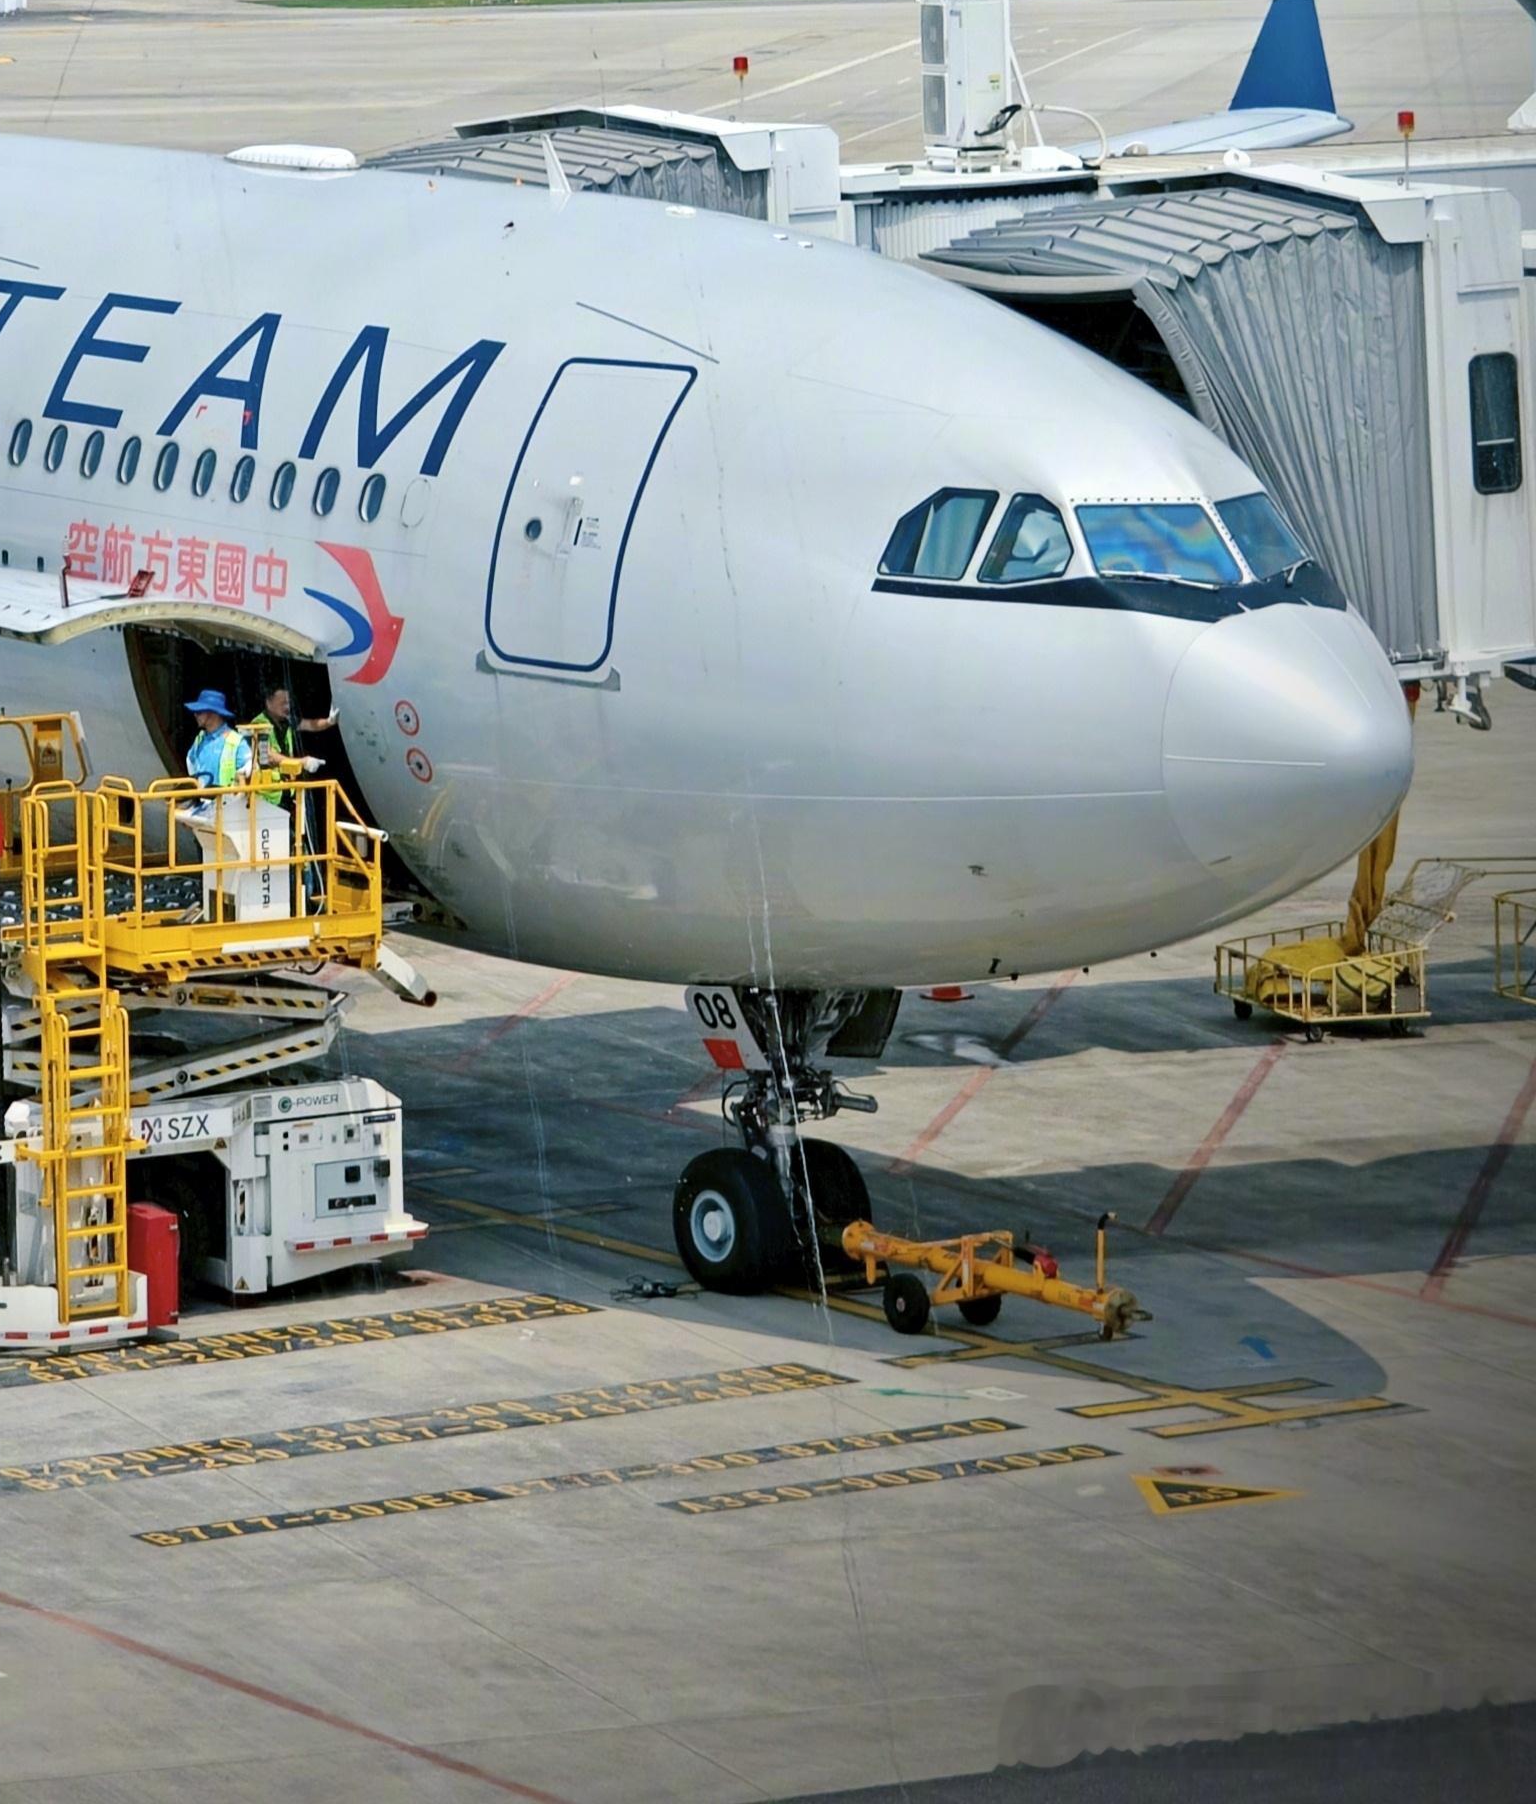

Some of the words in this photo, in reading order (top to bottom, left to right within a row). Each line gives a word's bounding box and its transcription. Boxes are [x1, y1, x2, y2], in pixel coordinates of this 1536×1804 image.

[694, 992, 737, 1029] 08
[167, 1114, 210, 1140] SZX
[140, 1489, 488, 1547] B777-300ER
[775, 1419, 1007, 1457] B787-10
[676, 1445, 1106, 1514] A350-900/1000
